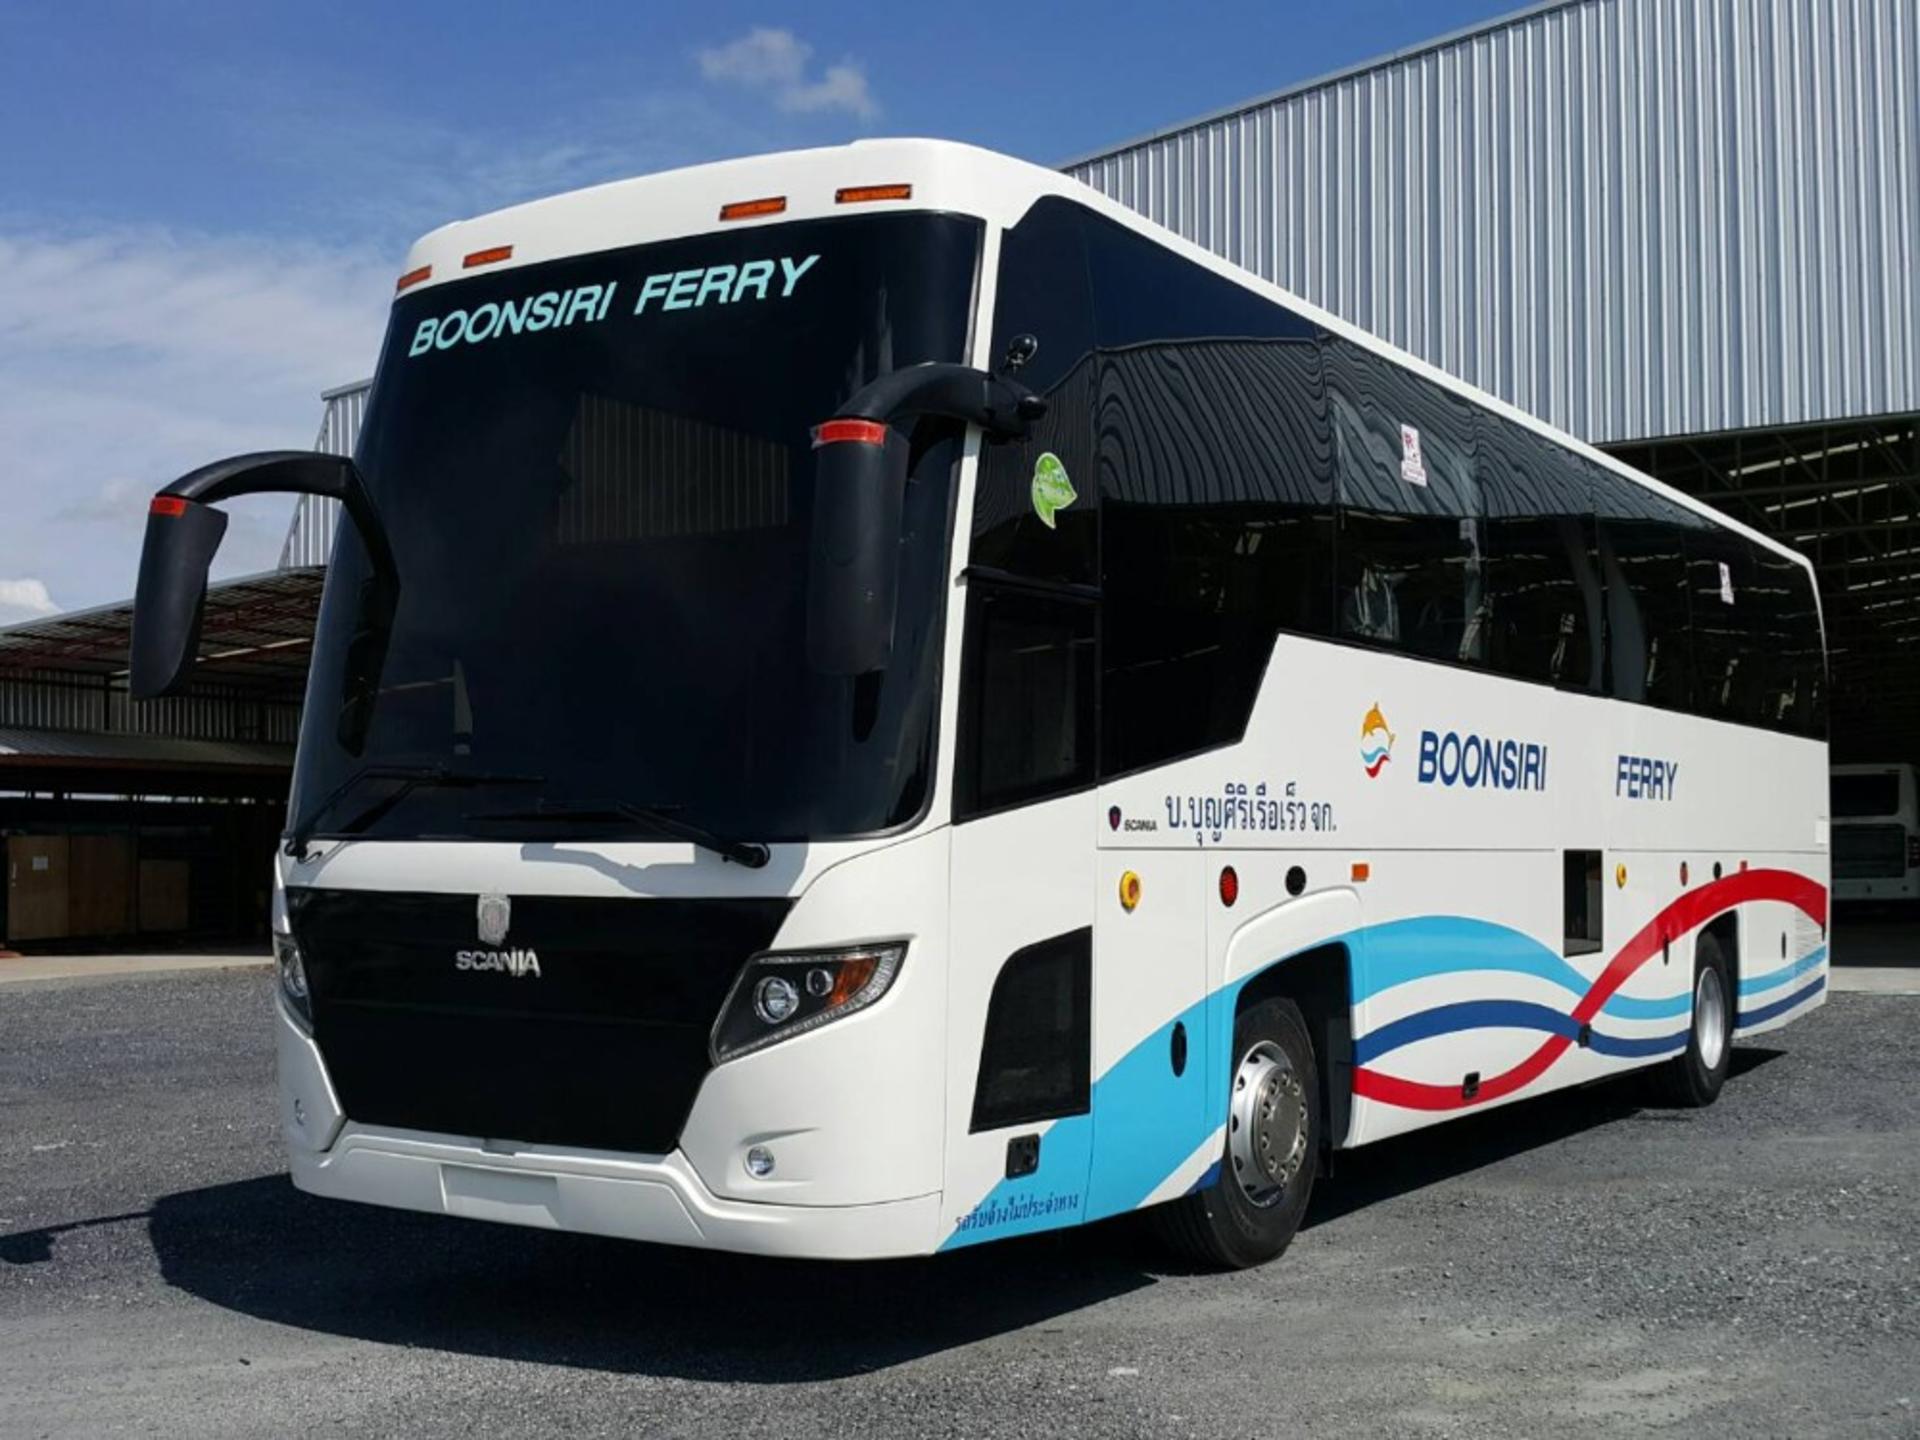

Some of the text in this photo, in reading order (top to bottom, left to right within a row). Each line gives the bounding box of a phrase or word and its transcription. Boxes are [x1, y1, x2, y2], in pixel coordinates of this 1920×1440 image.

[408, 254, 820, 357] BOONSIRI FERRY
[1418, 730, 1679, 801] BOONSIRI FERRY
[1124, 819, 1158, 832] SCANIA
[455, 946, 541, 978] SCANIA
